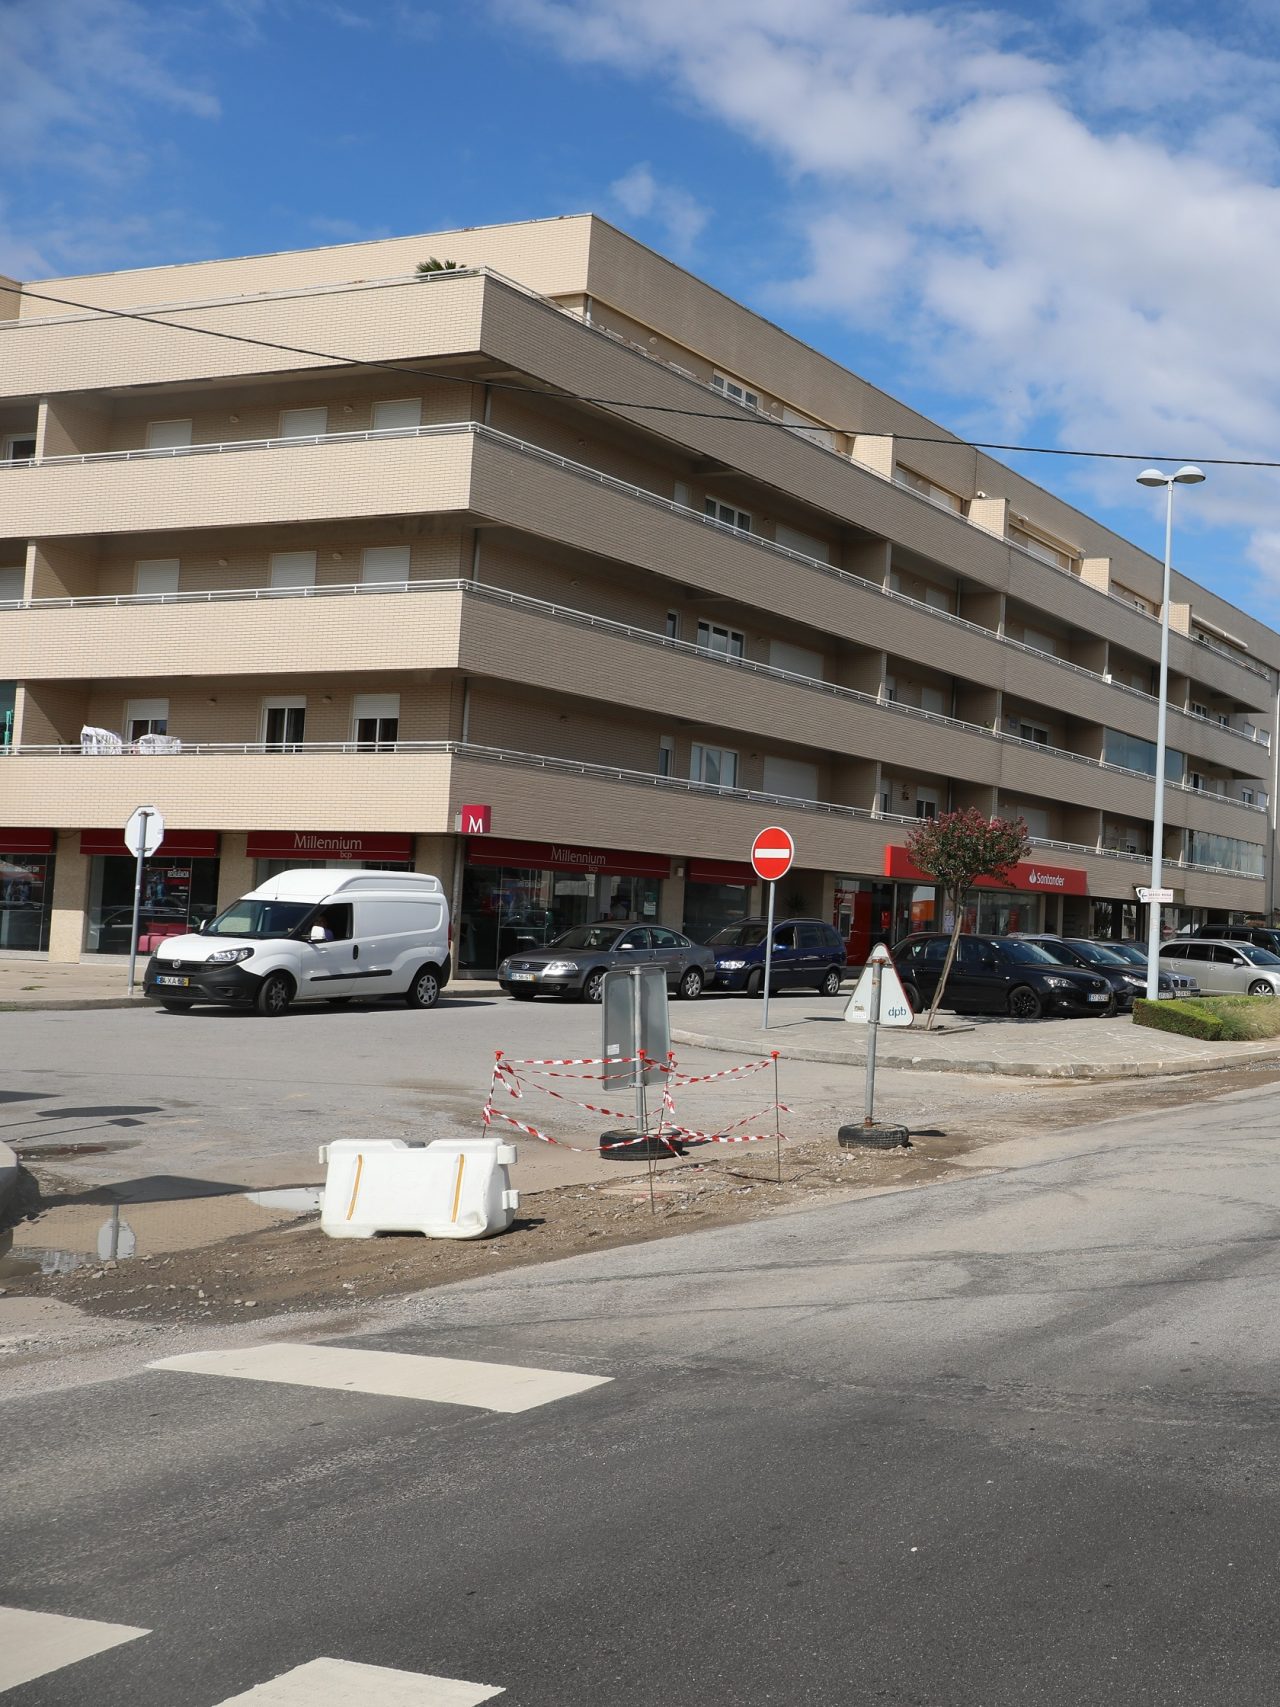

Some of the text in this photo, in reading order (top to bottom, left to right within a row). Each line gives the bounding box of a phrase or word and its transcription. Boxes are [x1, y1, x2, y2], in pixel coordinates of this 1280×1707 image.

[468, 814, 483, 833] M
[293, 832, 362, 850] Millennium
[340, 850, 353, 860] bcp
[550, 845, 606, 865] Millennium
[1036, 872, 1065, 886] Santander
[888, 1006, 907, 1018] dpb
